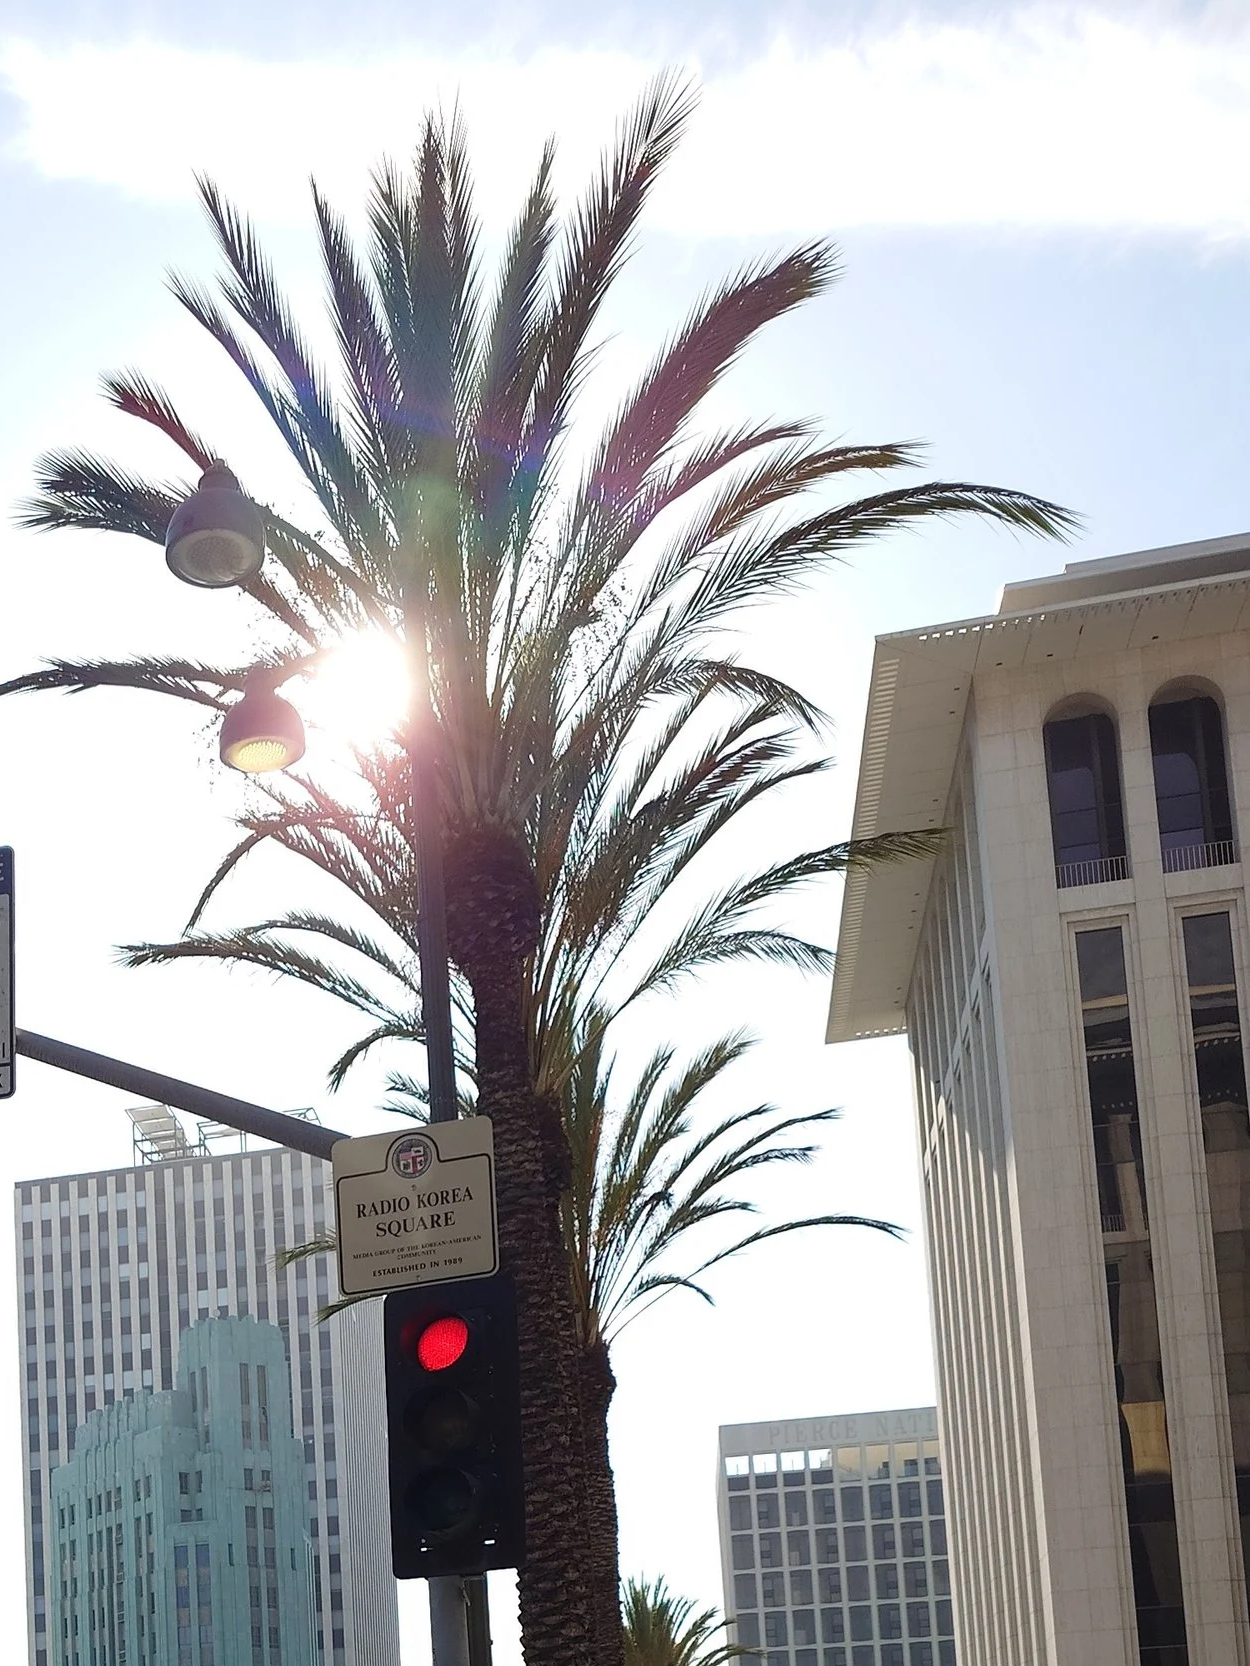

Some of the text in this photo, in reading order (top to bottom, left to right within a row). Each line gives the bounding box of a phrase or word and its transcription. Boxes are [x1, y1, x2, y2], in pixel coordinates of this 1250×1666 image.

[356, 1186, 474, 1219] RADIO KOREA
[376, 1210, 456, 1238] SQUARE
[352, 1234, 482, 1260] MEDIA GROUP OF THE KOREAN-AMERICAN
[397, 1249, 437, 1261] COMMUNITY
[372, 1257, 463, 1277] ESTABLISHED IN 1989
[769, 1419, 858, 1445] PIERCE
